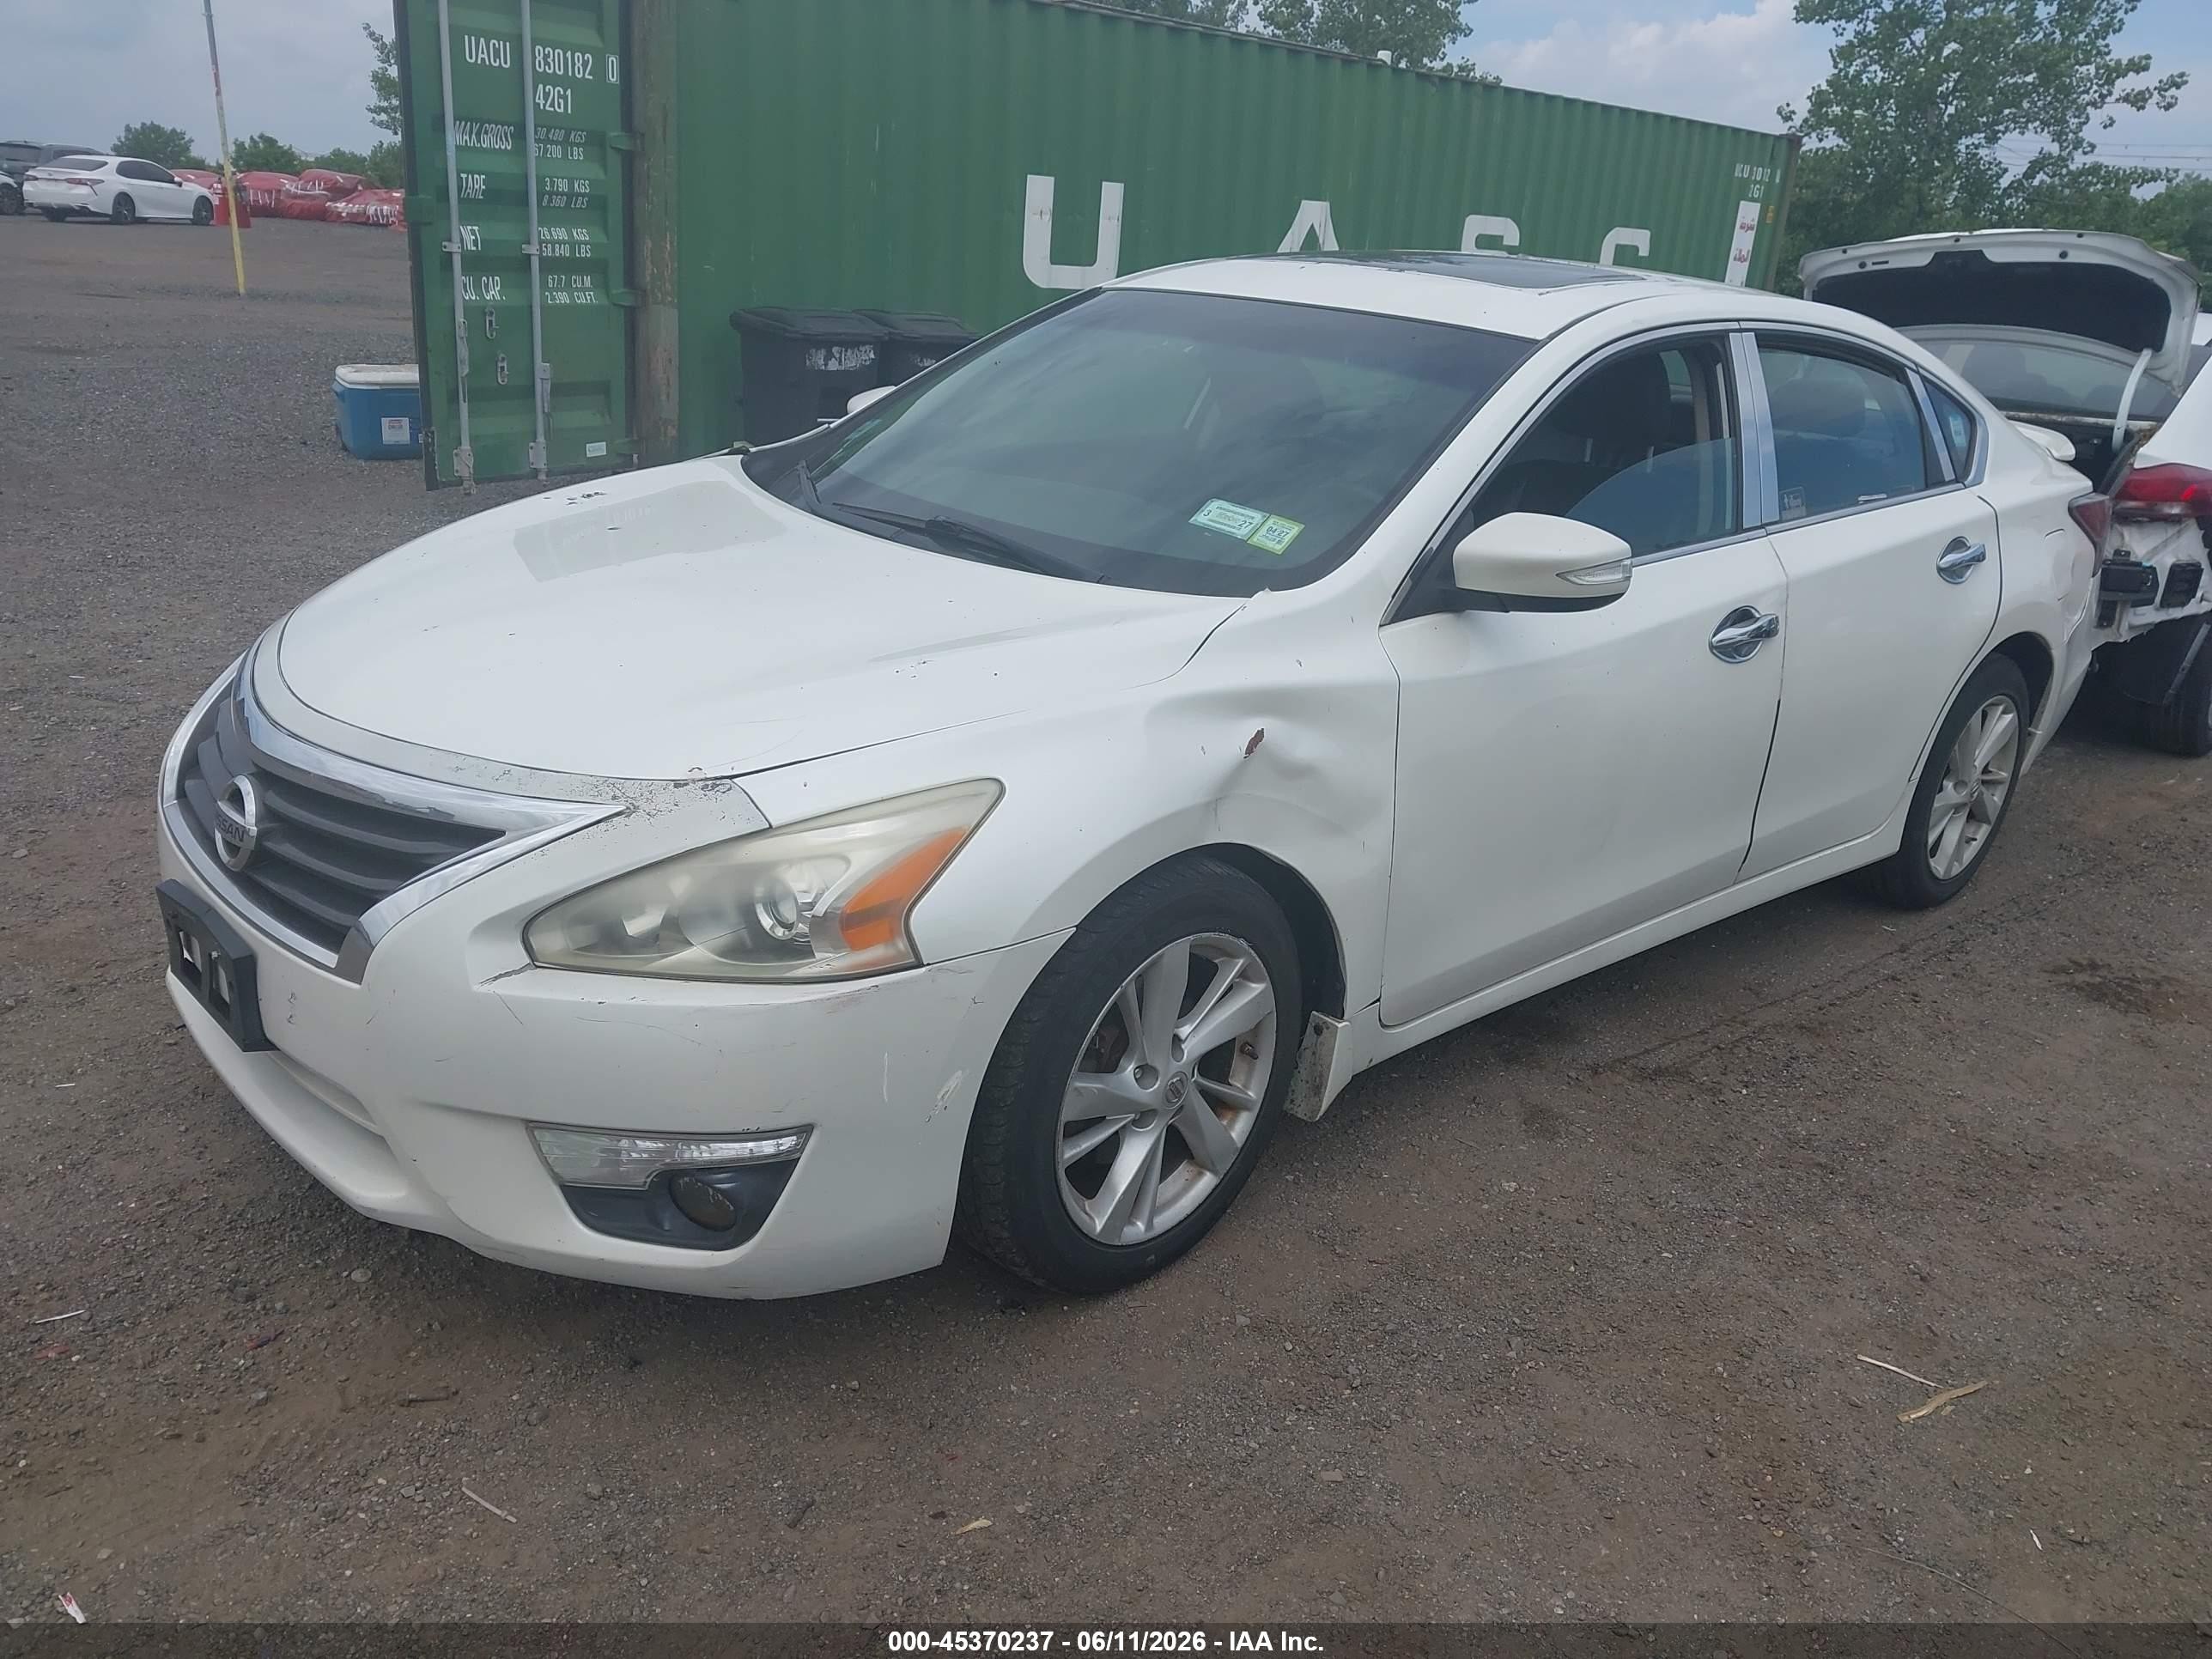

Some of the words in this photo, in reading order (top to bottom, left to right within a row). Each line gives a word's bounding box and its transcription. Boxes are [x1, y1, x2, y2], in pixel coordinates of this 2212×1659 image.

[464, 34, 511, 69] UACU
[535, 45, 593, 79] 830182
[607, 56, 617, 82] 0
[535, 83, 572, 114] 42G1
[569, 131, 586, 143] KGS
[568, 147, 584, 161] LBS
[459, 173, 486, 199] TARE
[544, 177, 568, 192] 3.790
[574, 179, 590, 193] KGS
[542, 195, 567, 208] 8.360
[570, 196, 588, 209] LBS
[459, 225, 482, 251] NET
[538, 227, 568, 240] 26.690
[572, 228, 590, 240] KGS
[542, 243, 570, 257] 58.840
[575, 244, 591, 258] LBS
[460, 276, 480, 301] CU.
[481, 276, 506, 301] CAP.
[548, 275, 566, 288] 67.7
[571, 275, 592, 289] CU.M.
[545, 292, 570, 304] 2.390
